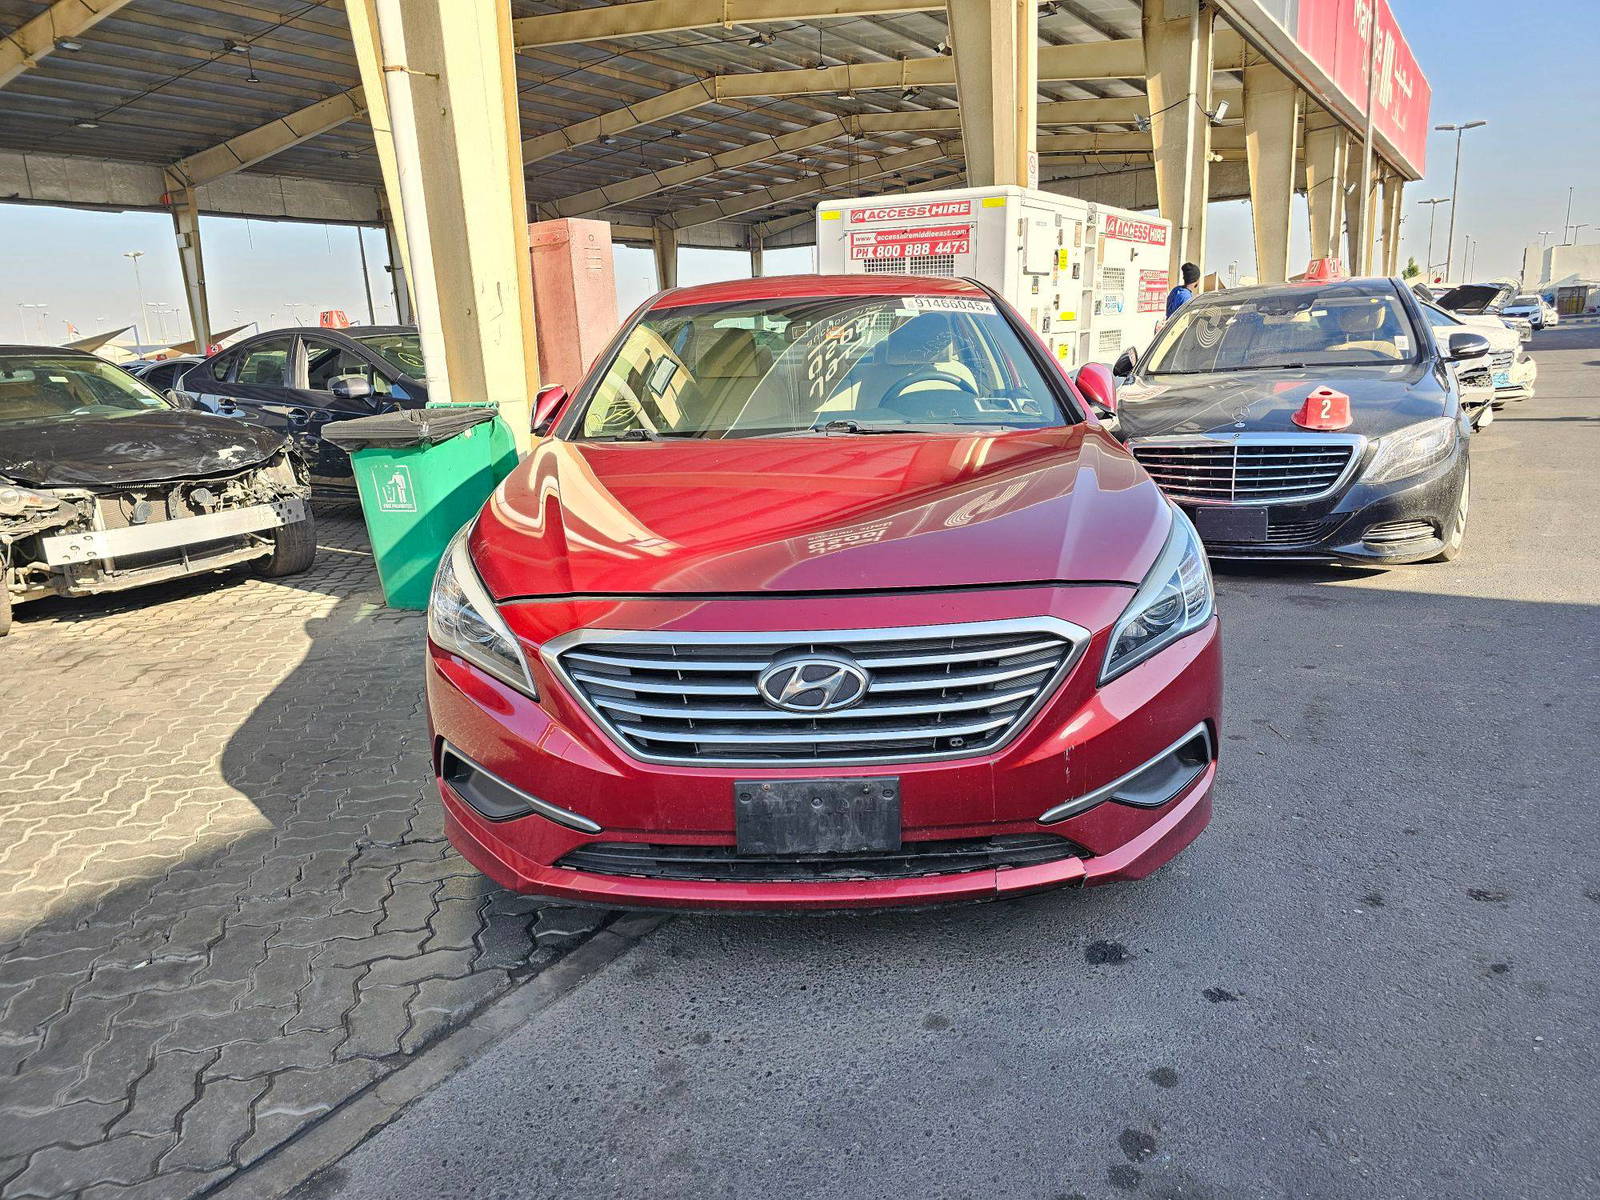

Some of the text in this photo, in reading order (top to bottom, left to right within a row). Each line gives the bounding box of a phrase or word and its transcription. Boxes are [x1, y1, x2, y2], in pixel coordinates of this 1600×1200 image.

[867, 206, 928, 219] ACCESS
[931, 203, 970, 215] HIRE
[1118, 221, 1149, 240] ACCESS
[856, 241, 968, 257] PH 800 888 4473
[1320, 399, 1332, 419] 2
